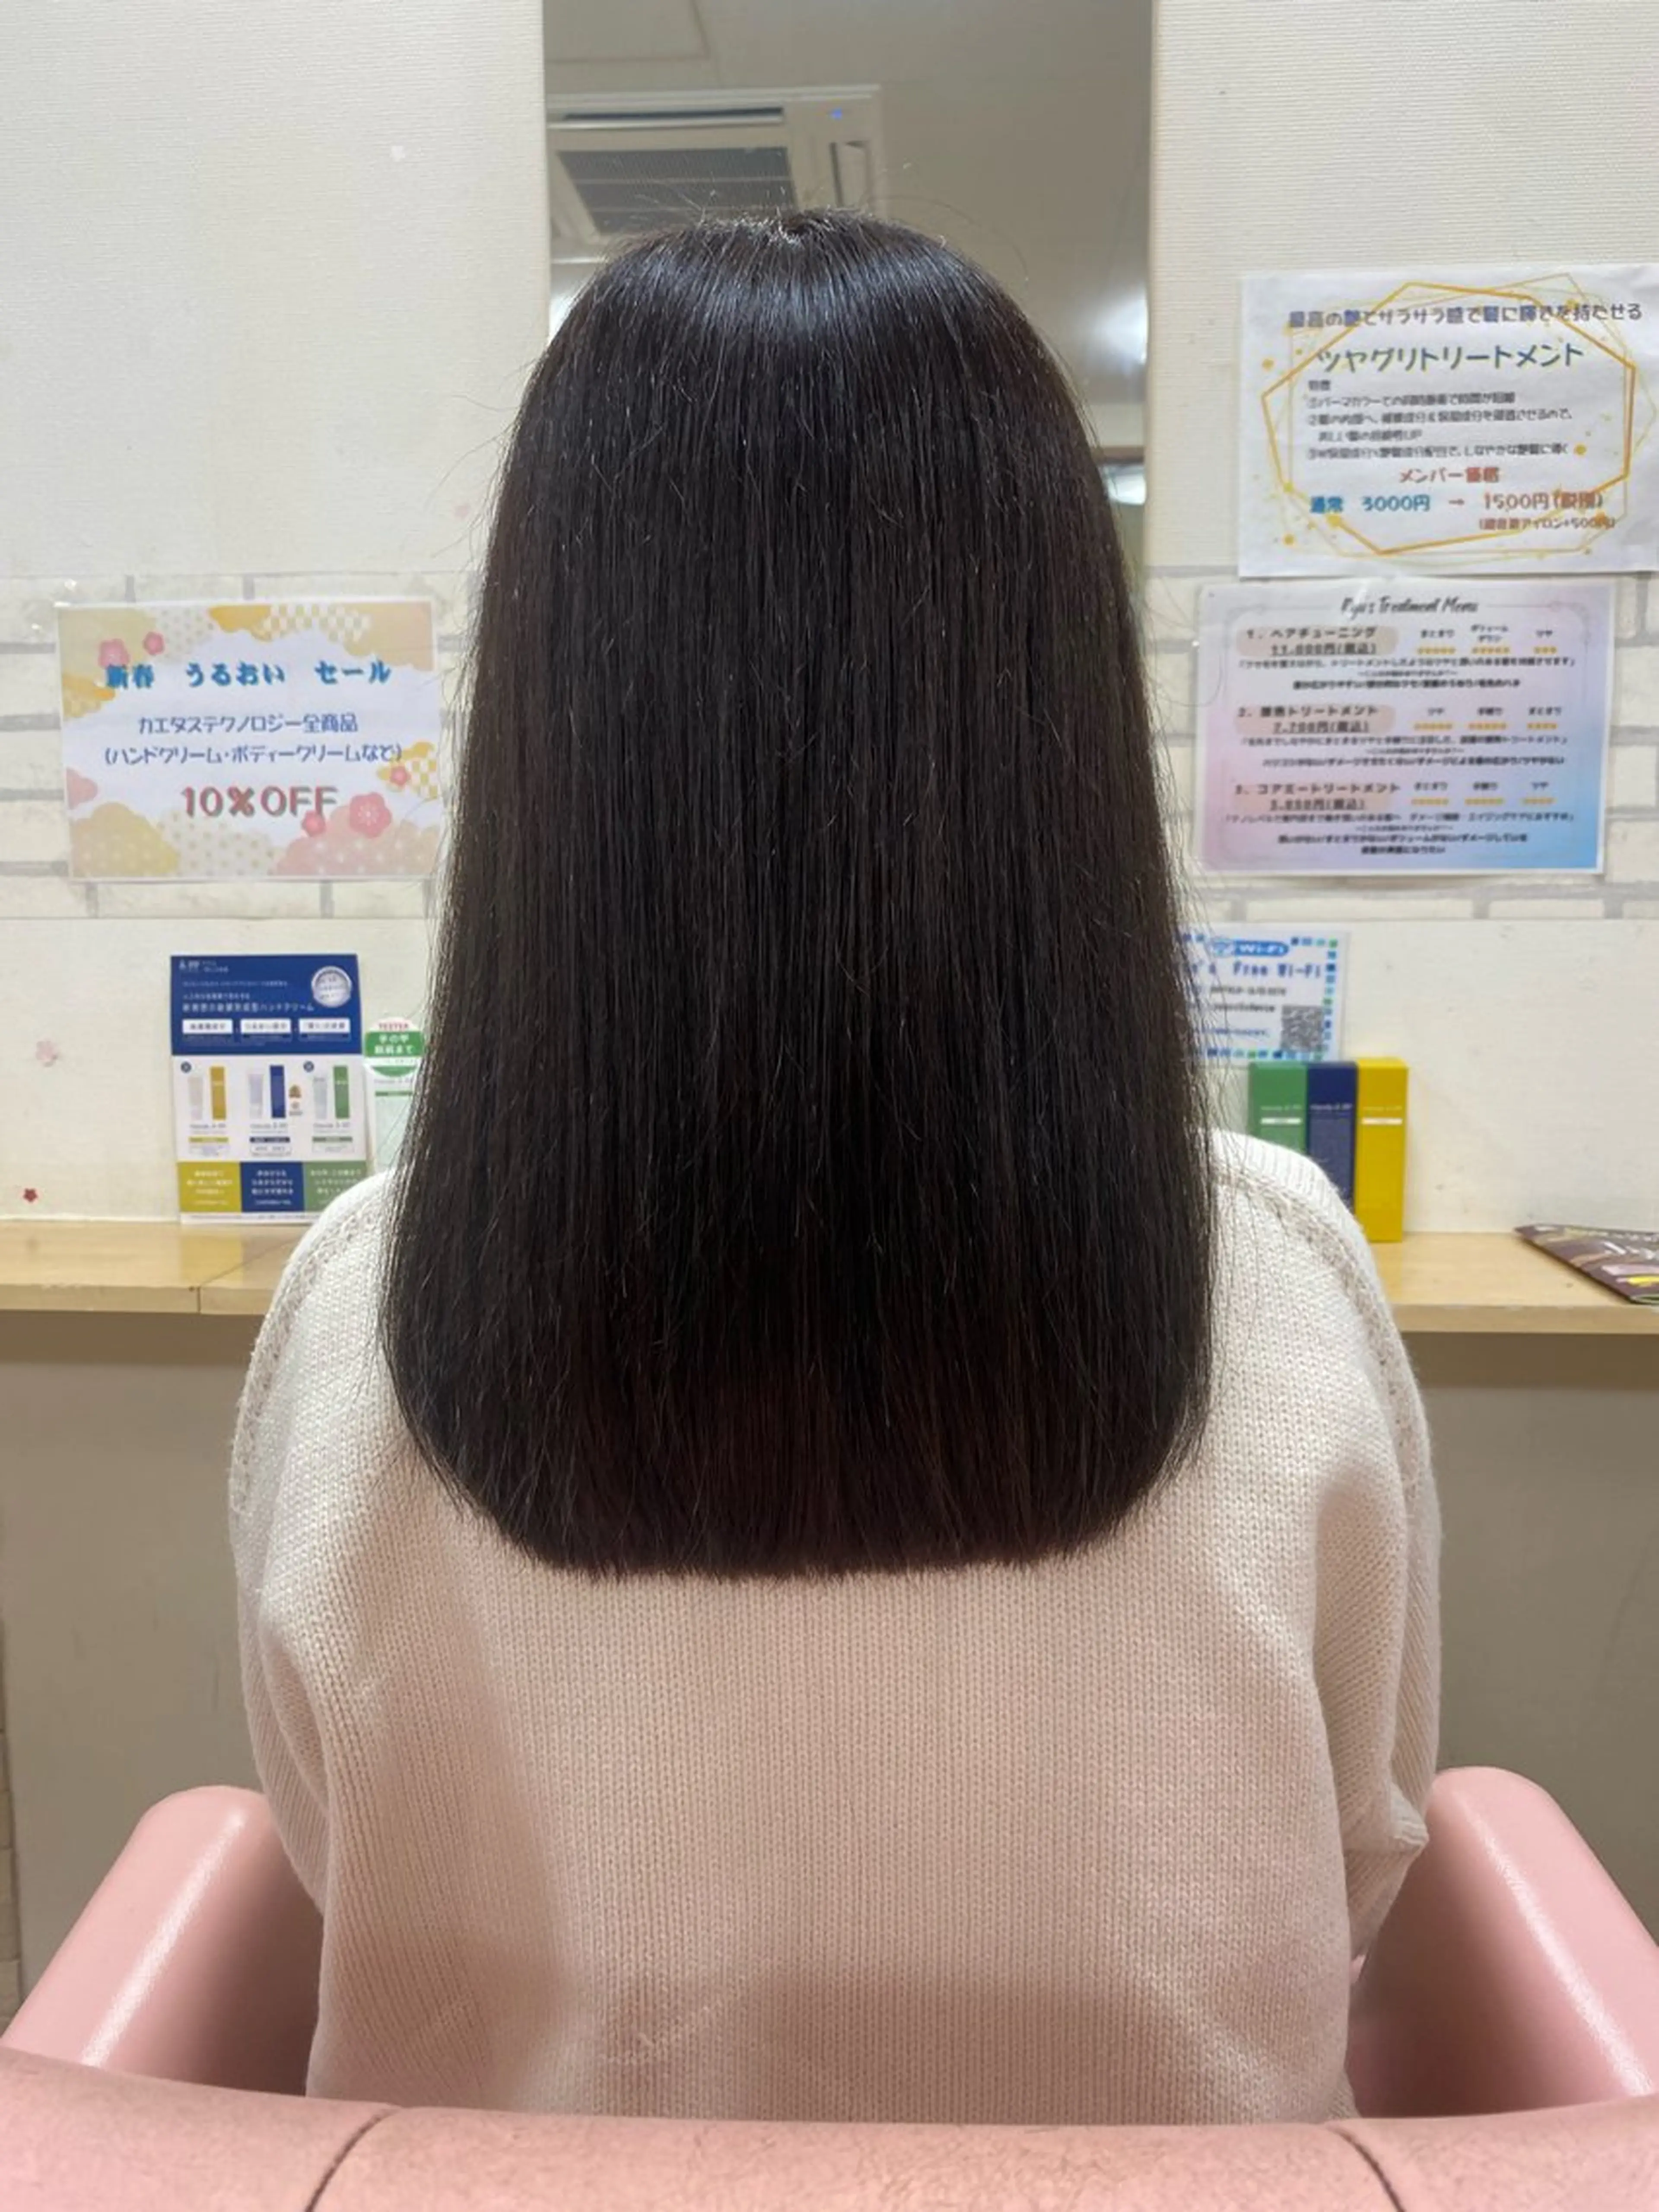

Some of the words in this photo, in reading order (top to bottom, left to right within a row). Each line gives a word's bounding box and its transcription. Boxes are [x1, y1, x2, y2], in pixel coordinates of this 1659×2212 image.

[1399, 467, 1499, 483] メンバー価格
[1362, 494, 1430, 512] 3000円
[106, 664, 155, 689] 新春
[185, 661, 286, 687] うるおい
[315, 659, 391, 685] セール
[138, 713, 359, 734] カエタステクノロジー全商品
[182, 785, 339, 818] 10%OFF
